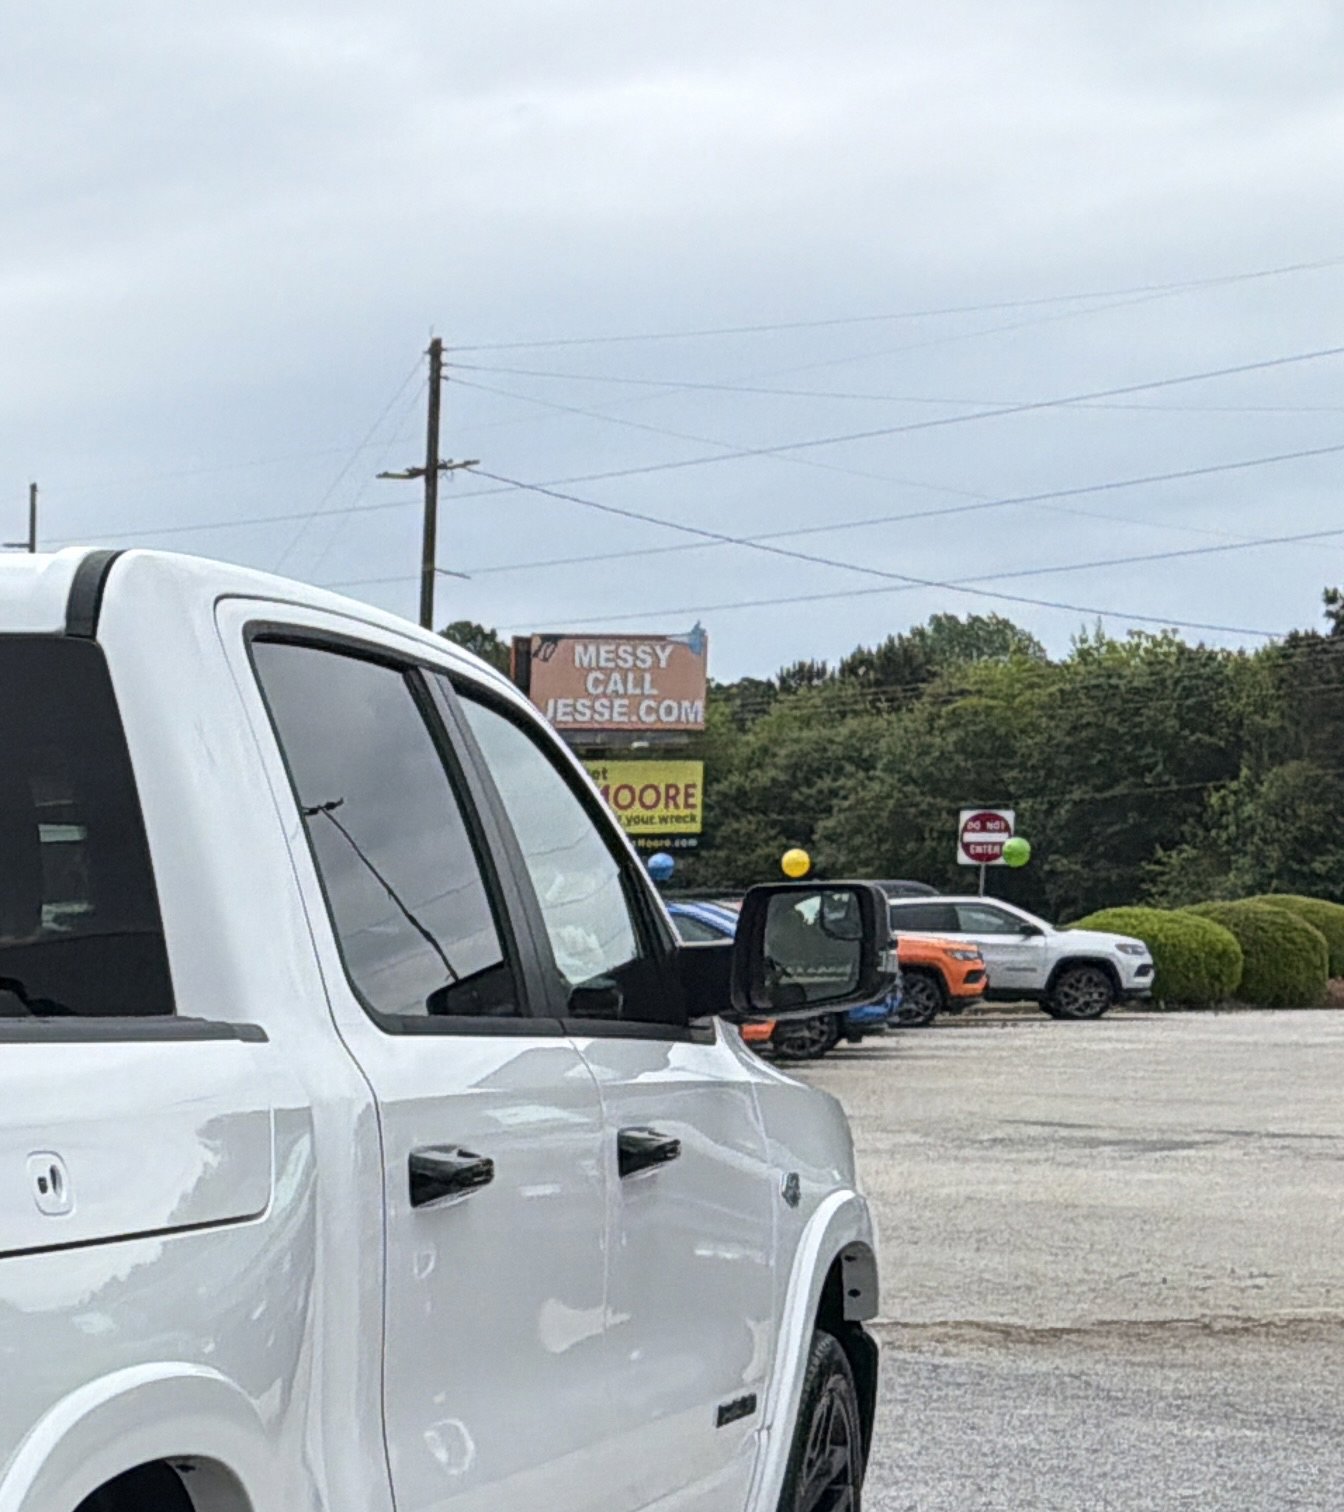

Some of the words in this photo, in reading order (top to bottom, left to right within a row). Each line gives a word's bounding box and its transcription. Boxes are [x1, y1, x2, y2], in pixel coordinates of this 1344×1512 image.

[574, 644, 674, 669] MESSY
[586, 671, 659, 695] CALL
[546, 699, 704, 723] JESSE.COM
[590, 767, 609, 780] ot
[626, 815, 656, 826] your
[658, 813, 698, 825] wreck
[967, 820, 981, 830] DO
[986, 820, 1005, 830] NOT
[969, 844, 1001, 855] ENTER
